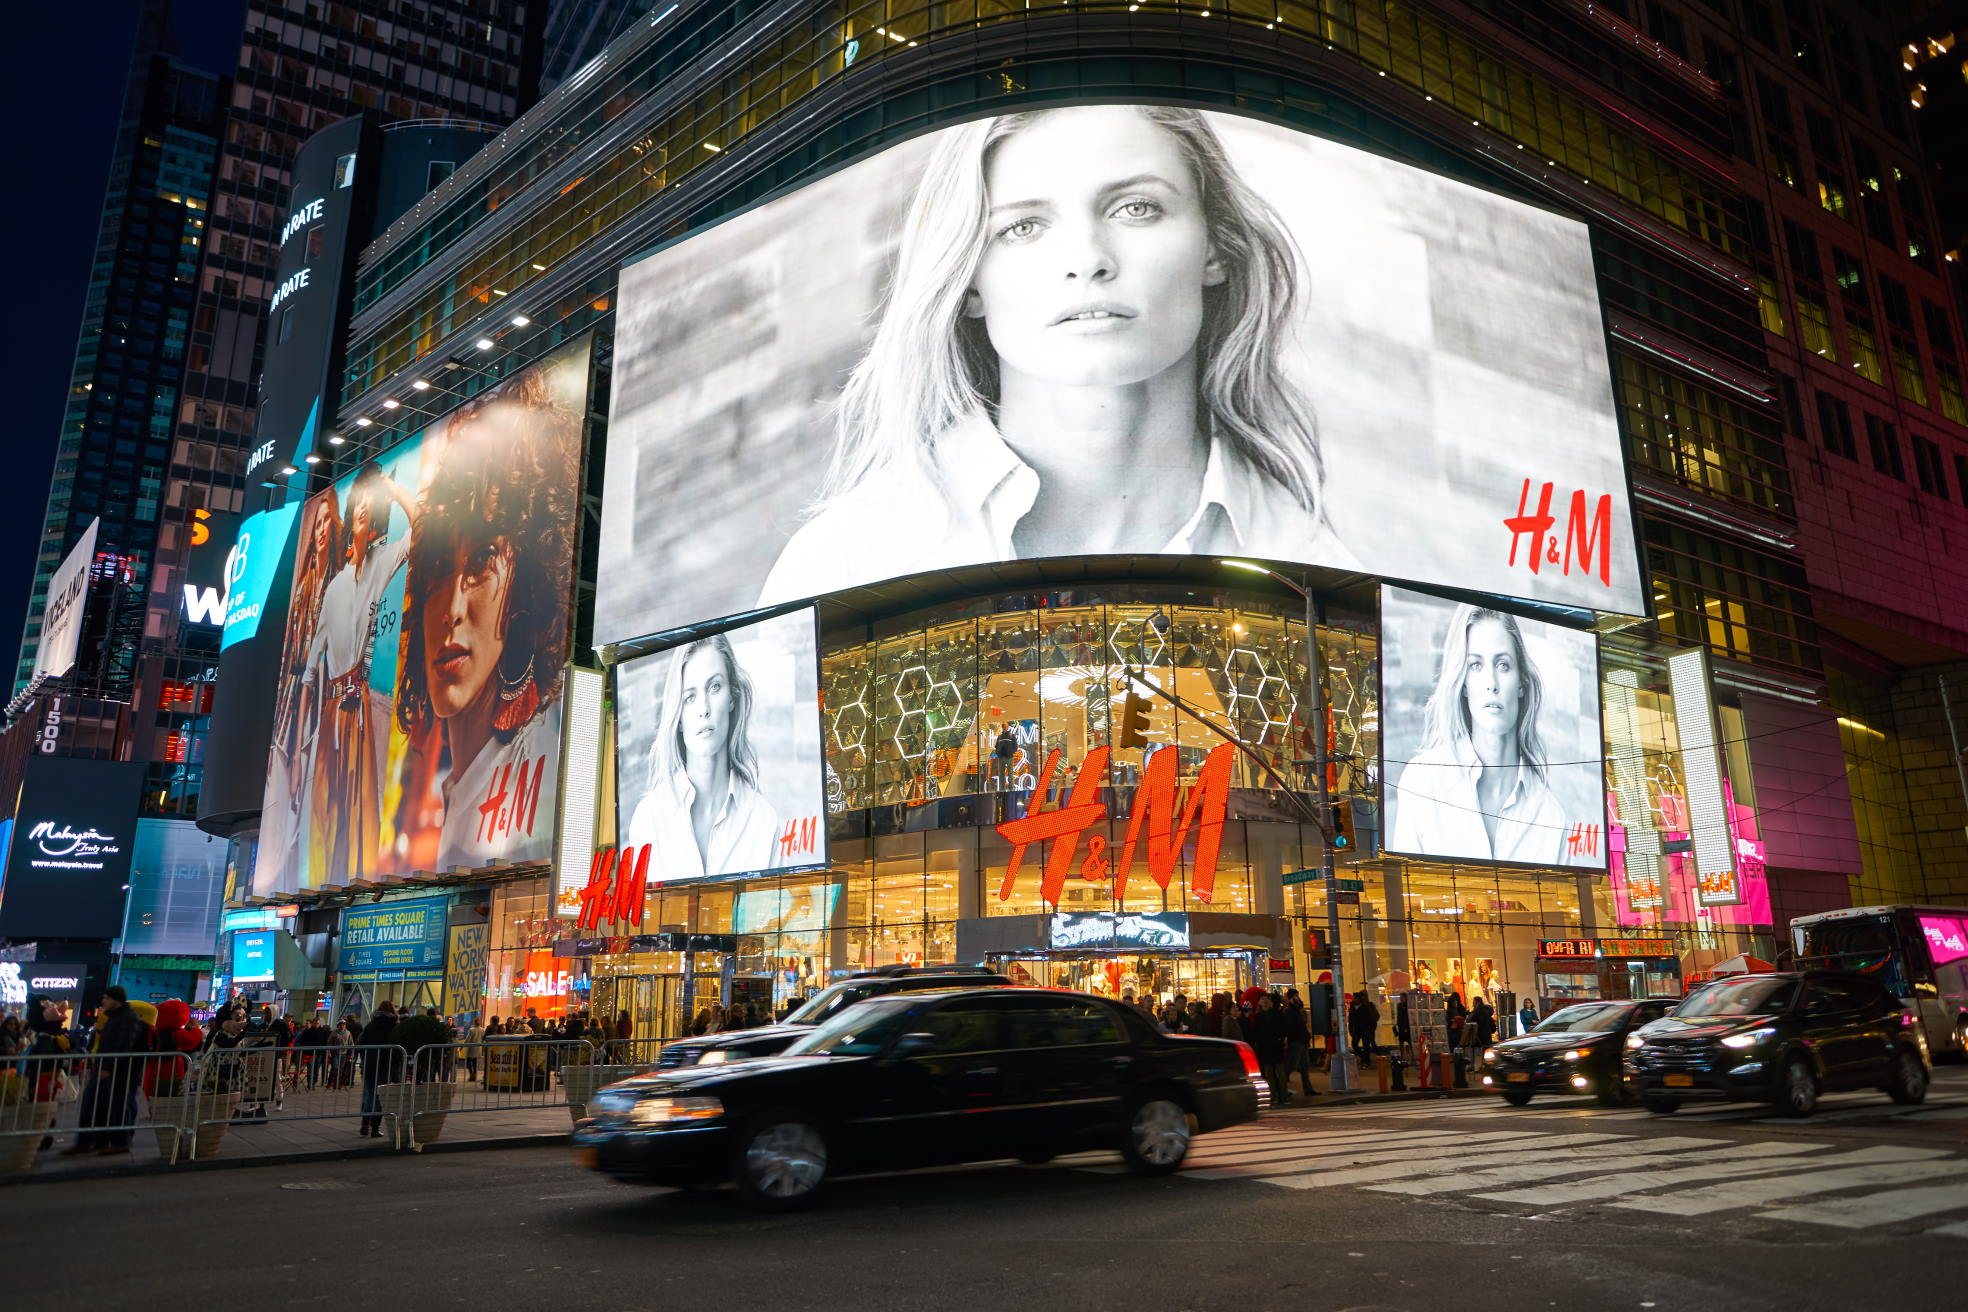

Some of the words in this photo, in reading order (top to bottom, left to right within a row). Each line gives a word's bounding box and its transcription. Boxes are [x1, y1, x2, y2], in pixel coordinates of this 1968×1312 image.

[290, 198, 325, 235] RATE
[280, 268, 311, 301] RATE
[251, 440, 276, 472] RATE
[1503, 477, 1612, 588] H&M
[41, 697, 62, 753] 1500
[477, 754, 546, 844] H&M
[28, 821, 115, 855] Malaysia
[779, 815, 818, 857] H&M
[995, 741, 1236, 907] H&M
[1567, 821, 1599, 859] H&M
[577, 843, 652, 931] H&M
[347, 928, 374, 944] RETAIL
[376, 924, 425, 941] AVAILABLE
[348, 916, 371, 929] PRIME
[372, 913, 393, 927] TIMES
[395, 911, 425, 925] SQUARE
[457, 926, 485, 948] NEW
[453, 945, 487, 972] YORK
[31, 977, 79, 990] CITIZEN
[527, 970, 568, 997] SALE
[453, 991, 479, 1013] TAXI
